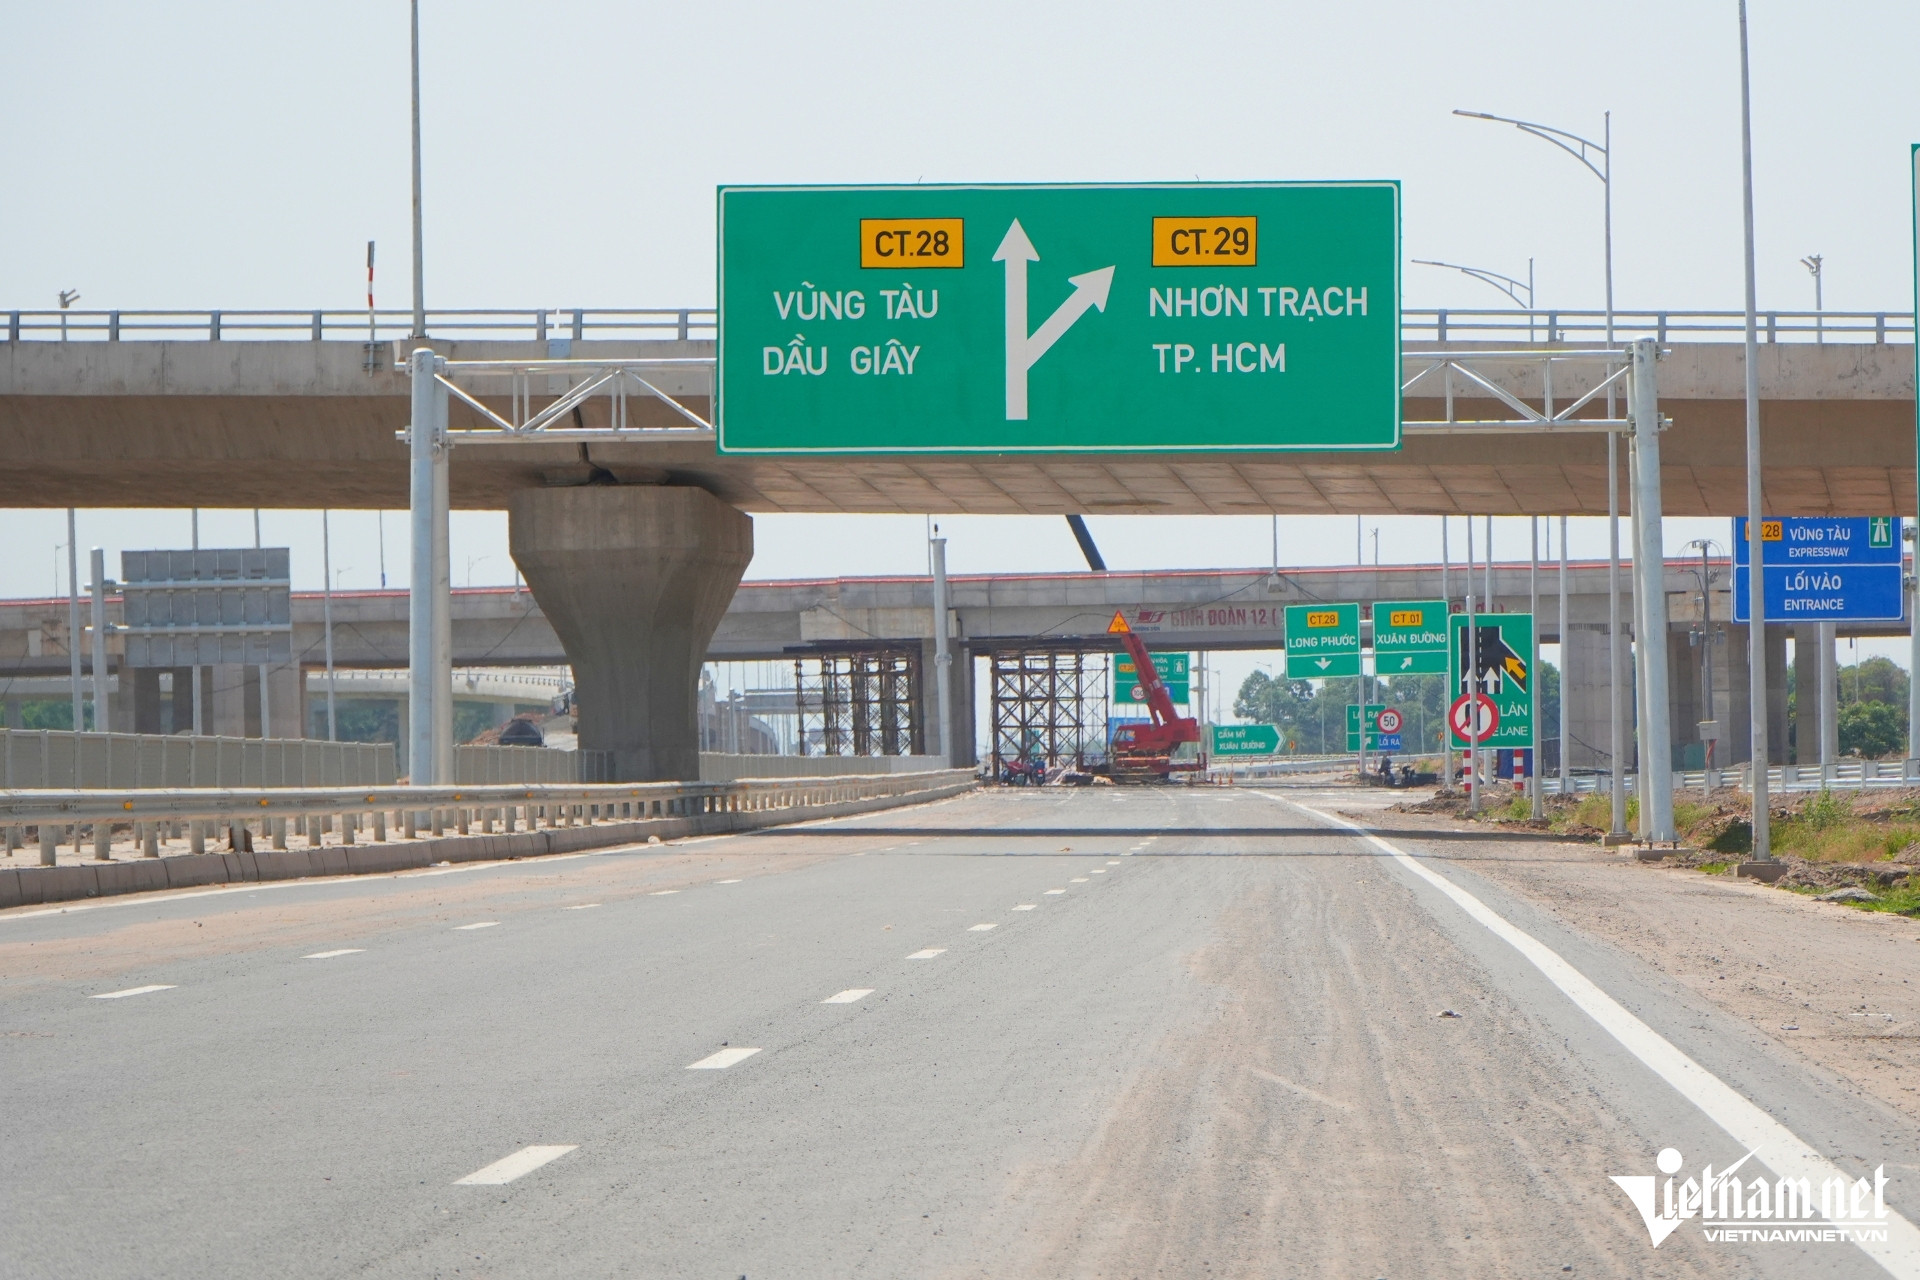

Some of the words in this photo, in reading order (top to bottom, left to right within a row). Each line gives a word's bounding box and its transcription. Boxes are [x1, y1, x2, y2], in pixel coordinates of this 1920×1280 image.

[875, 229, 950, 258] CT.28
[1170, 226, 1250, 256] CT.29
[773, 281, 865, 321] VŨNG
[879, 284, 938, 318] TÀU
[1149, 284, 1248, 318] NHƠN
[1257, 285, 1368, 322] TRẠCH
[763, 333, 828, 376] DẦU
[850, 339, 921, 375] GIÂY
[1152, 343, 1201, 373] TP.
[1211, 343, 1286, 373] HCM
[1790, 527, 1824, 541] VŨNG
[1828, 525, 1851, 541] TÀU
[1789, 547, 1849, 558] EXPRESSWAY
[1785, 570, 1809, 591] LỐI
[1811, 573, 1842, 591] VÀO
[1784, 598, 1844, 611] ENTRANCE
[1208, 606, 1247, 626] ĐOÀN
[1251, 608, 1267, 625] 12
[1309, 614, 1336, 625] CT.28
[1289, 637, 1318, 648] LONG
[1321, 633, 1356, 647] PHƯỚC
[1377, 633, 1407, 645] XUÂN
[1410, 631, 1446, 644] ĐƯỜNG
[1500, 701, 1528, 717] LÀN
[1384, 715, 1395, 727] 50
[1500, 726, 1528, 736] LANE
[1391, 738, 1401, 746] RA
